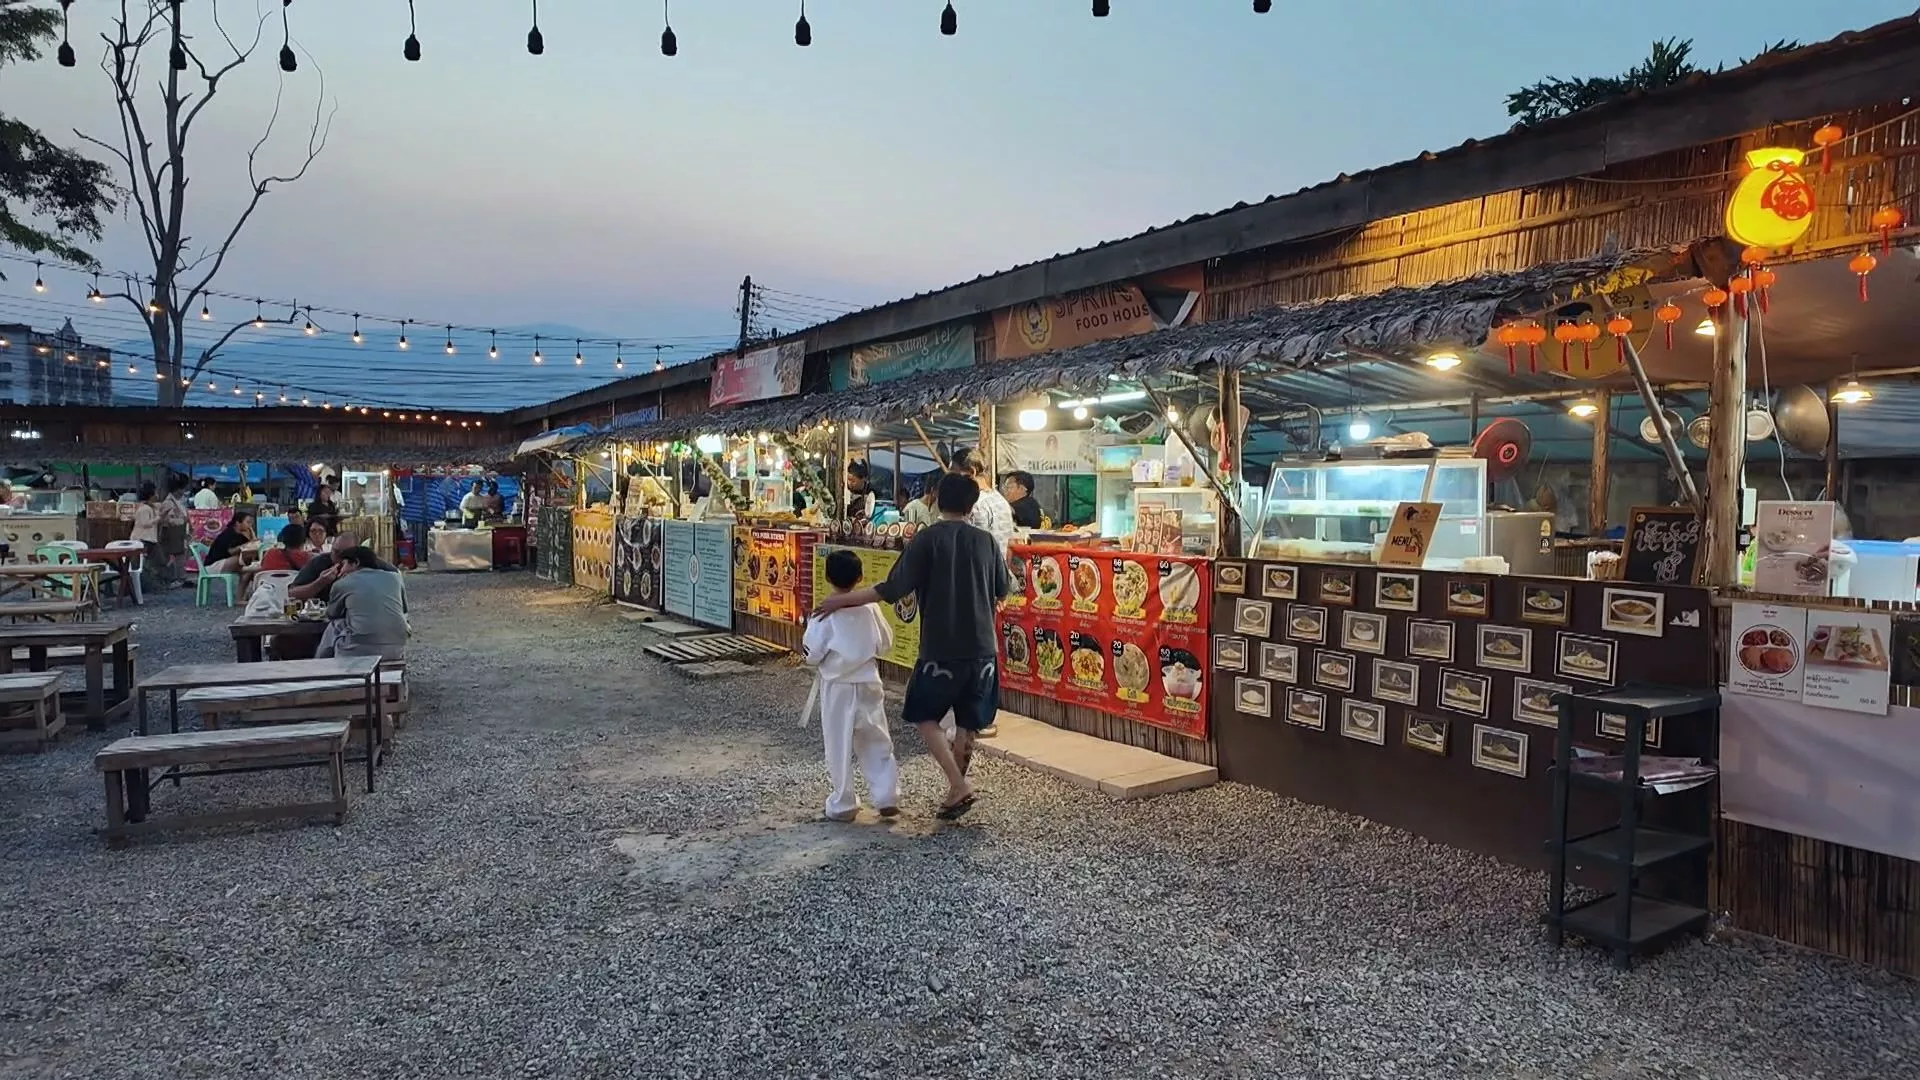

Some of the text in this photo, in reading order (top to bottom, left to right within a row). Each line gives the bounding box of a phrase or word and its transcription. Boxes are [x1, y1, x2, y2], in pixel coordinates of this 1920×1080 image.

[1076, 313, 1108, 331] FOOD
[1778, 508, 1813, 516] Dessert
[1392, 536, 1413, 546] MENU
[1070, 630, 1080, 639] 20
[1113, 640, 1122, 649] 20
